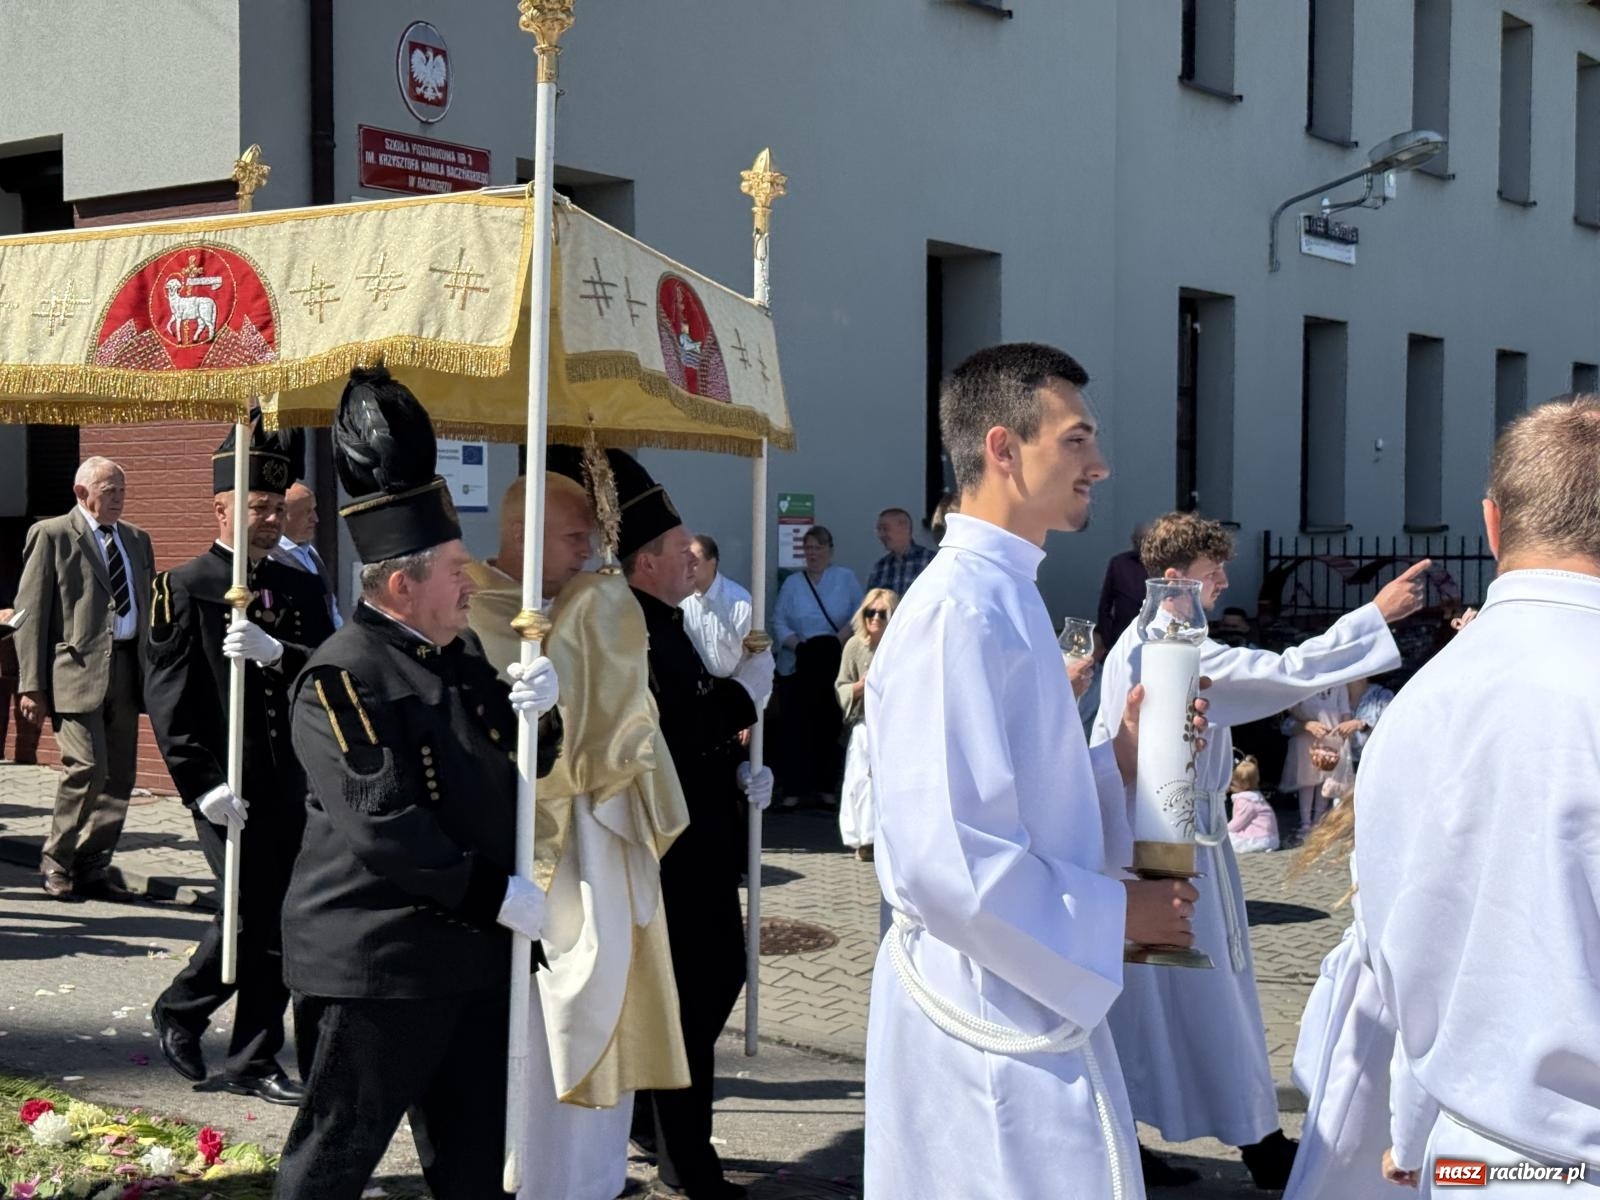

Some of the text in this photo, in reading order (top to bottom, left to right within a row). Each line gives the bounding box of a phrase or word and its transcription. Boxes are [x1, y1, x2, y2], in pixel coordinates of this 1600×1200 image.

[384, 137, 411, 154] SZKOŁA
[378, 152, 419, 172] KRZYSZTOFA
[421, 159, 445, 175] KAMILA
[408, 175, 416, 188] W
